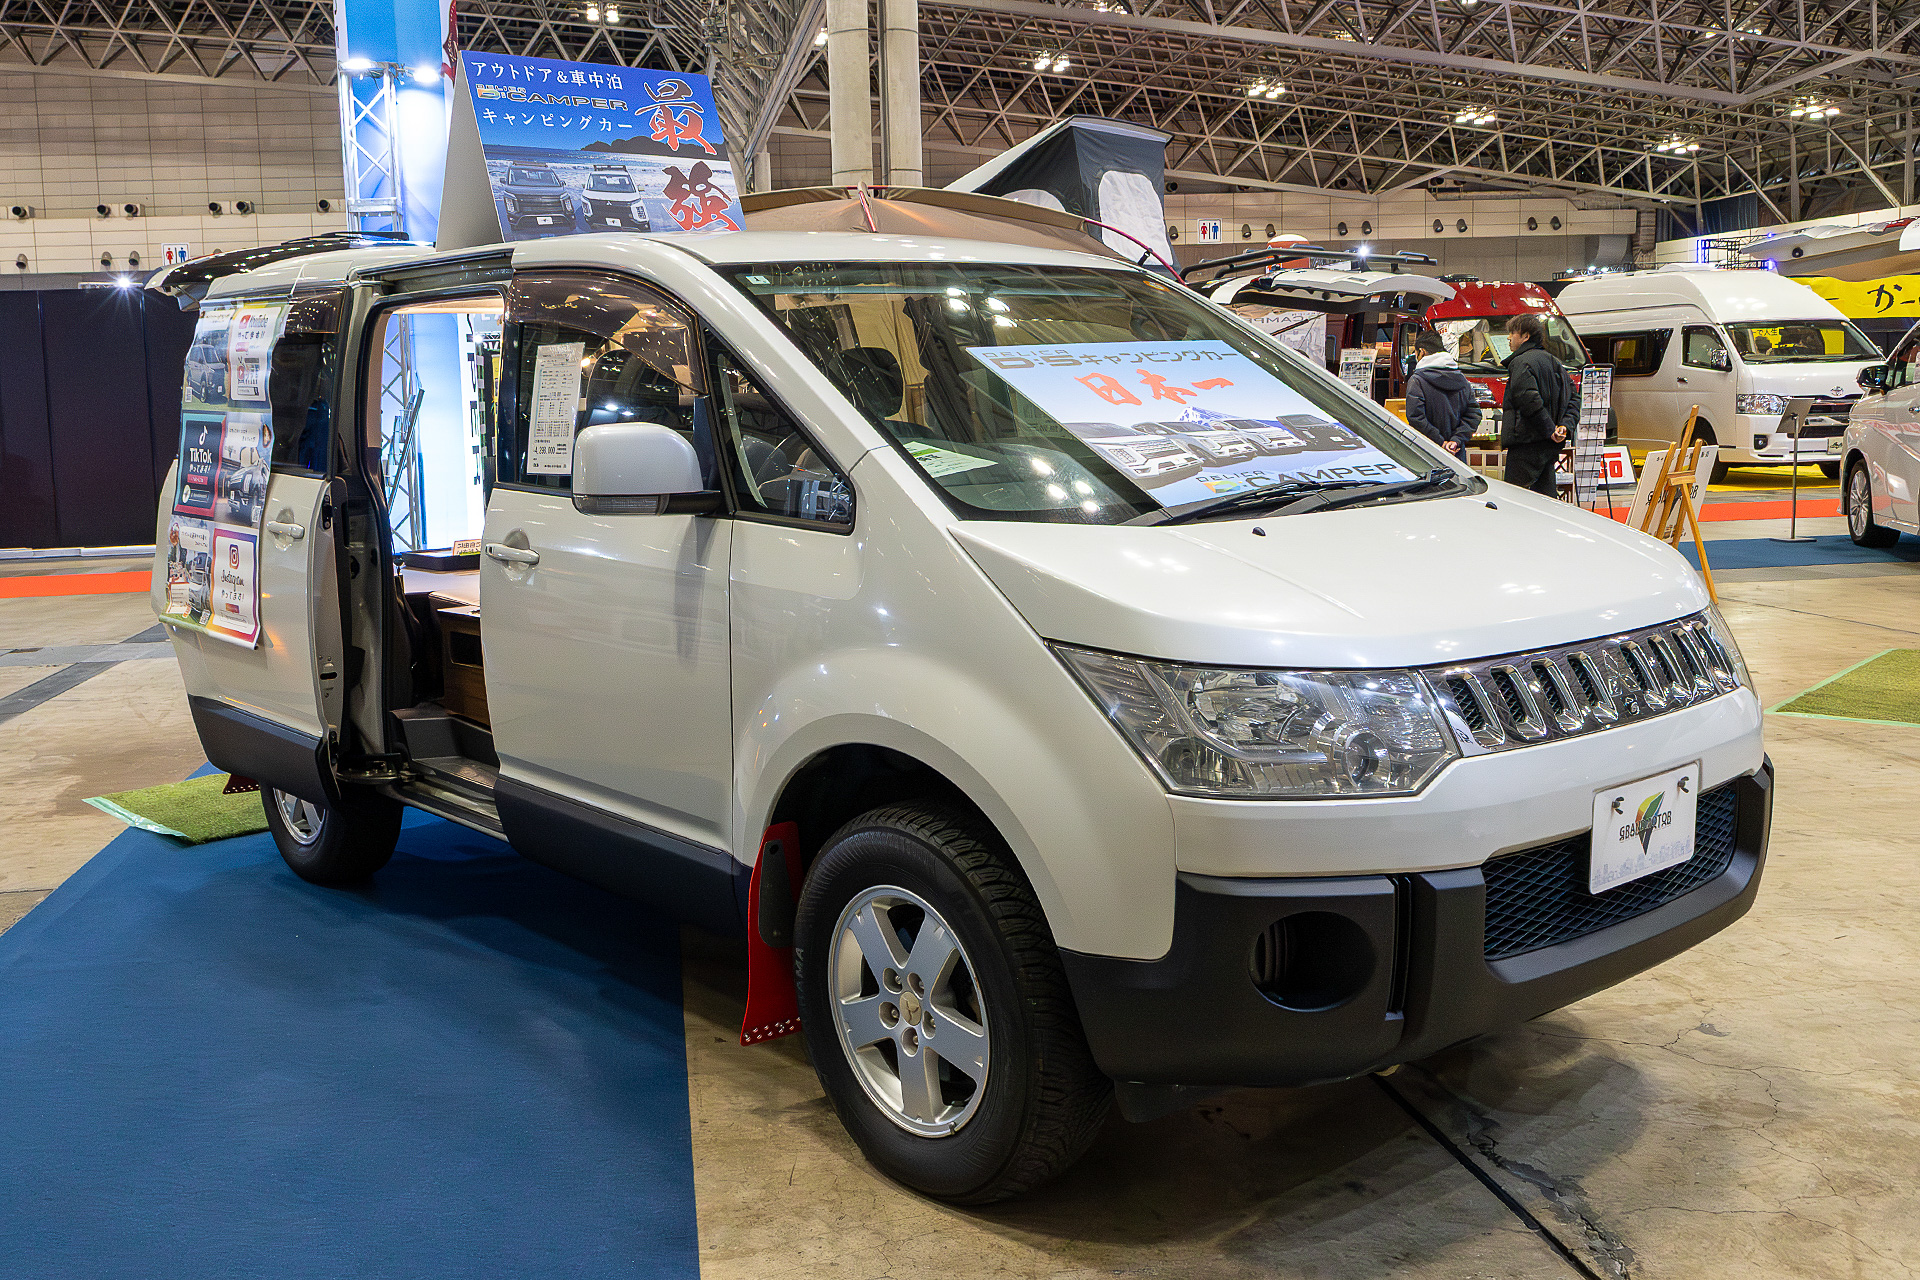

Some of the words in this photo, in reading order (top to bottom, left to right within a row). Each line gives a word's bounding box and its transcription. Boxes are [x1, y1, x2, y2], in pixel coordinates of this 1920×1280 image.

[482, 108, 633, 132] キャンピングカー
[982, 349, 1069, 359] DELICA
[1073, 368, 1235, 407] 日本一
[189, 447, 213, 465] TikTok
[1195, 470, 1265, 483] DELICA
